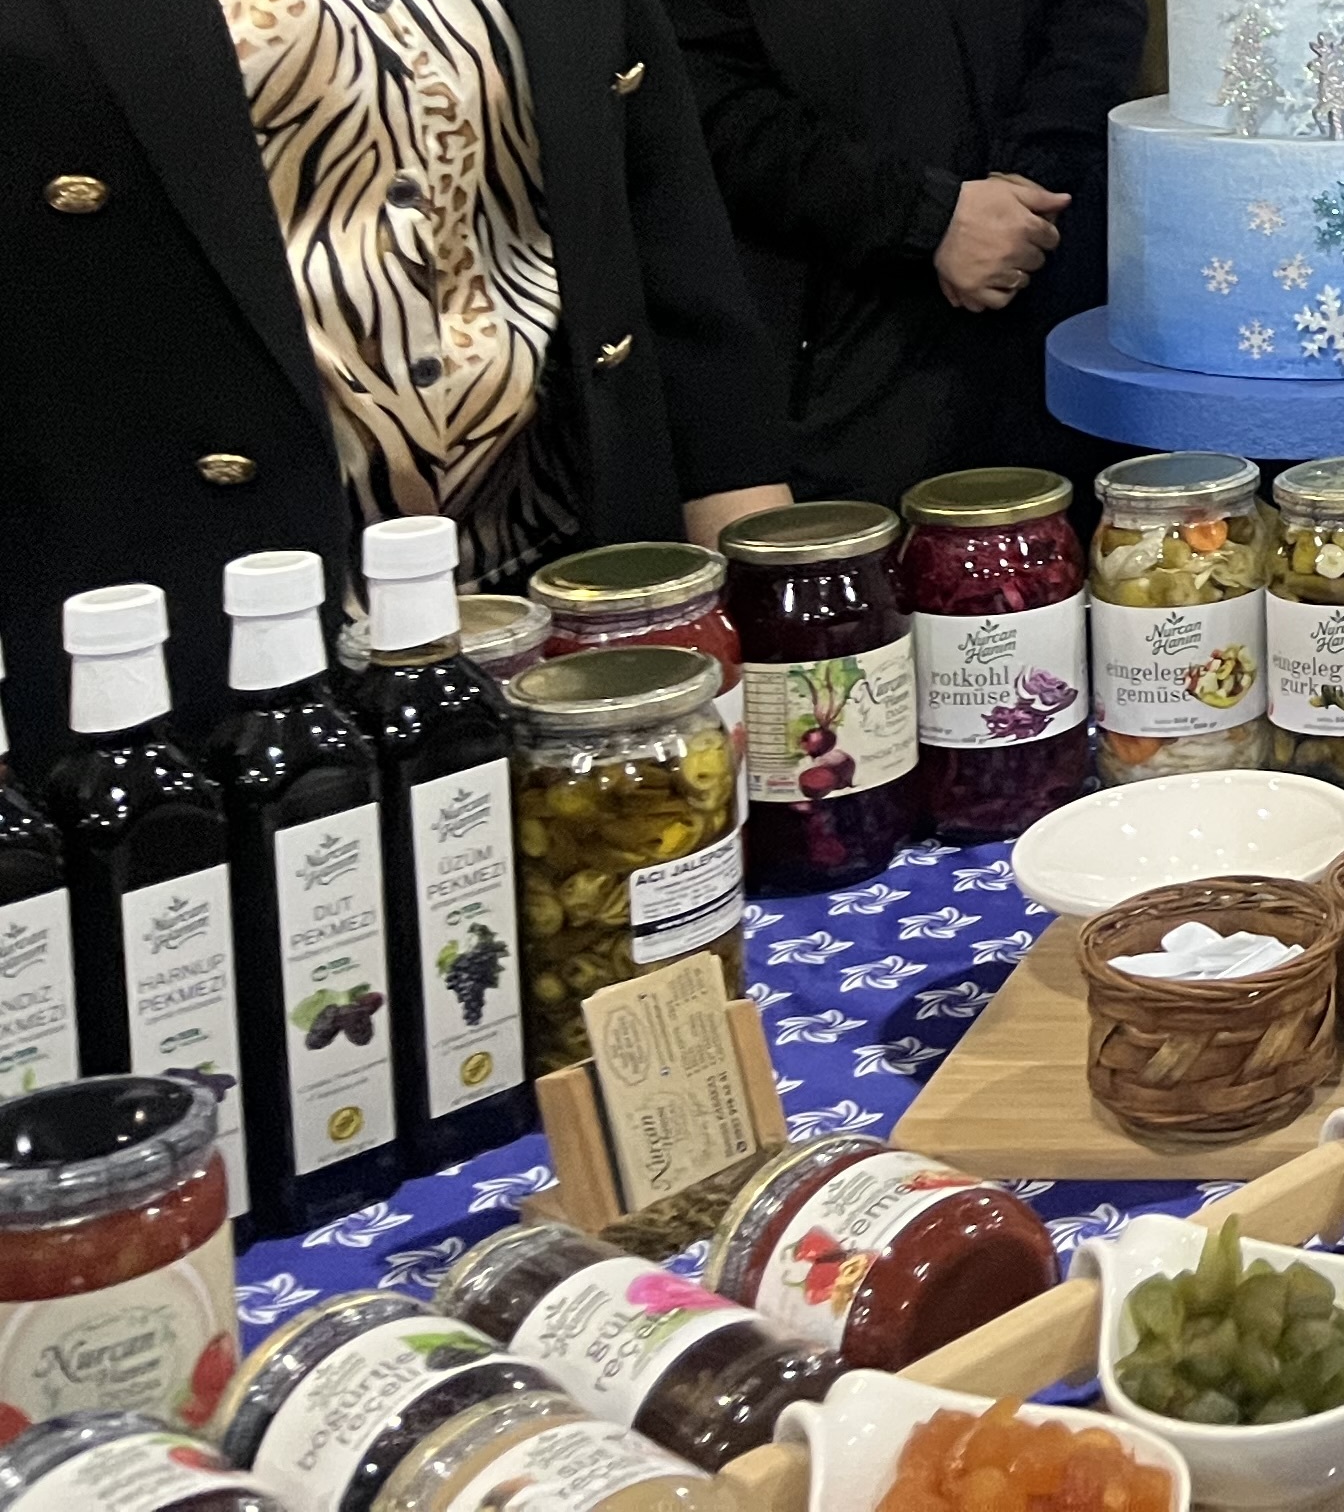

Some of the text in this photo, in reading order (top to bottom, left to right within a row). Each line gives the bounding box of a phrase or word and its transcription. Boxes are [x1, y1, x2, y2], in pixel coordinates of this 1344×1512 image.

[958, 629, 1017, 651] Nurcan
[1145, 621, 1202, 642] Nurcan
[930, 665, 1010, 688] rotkohl
[1105, 660, 1206, 686] eingelegte
[1116, 686, 1191, 707] gemüse
[1280, 677, 1343, 696] gurk
[928, 688, 1011, 709] gemüse
[313, 894, 355, 922] DUT
